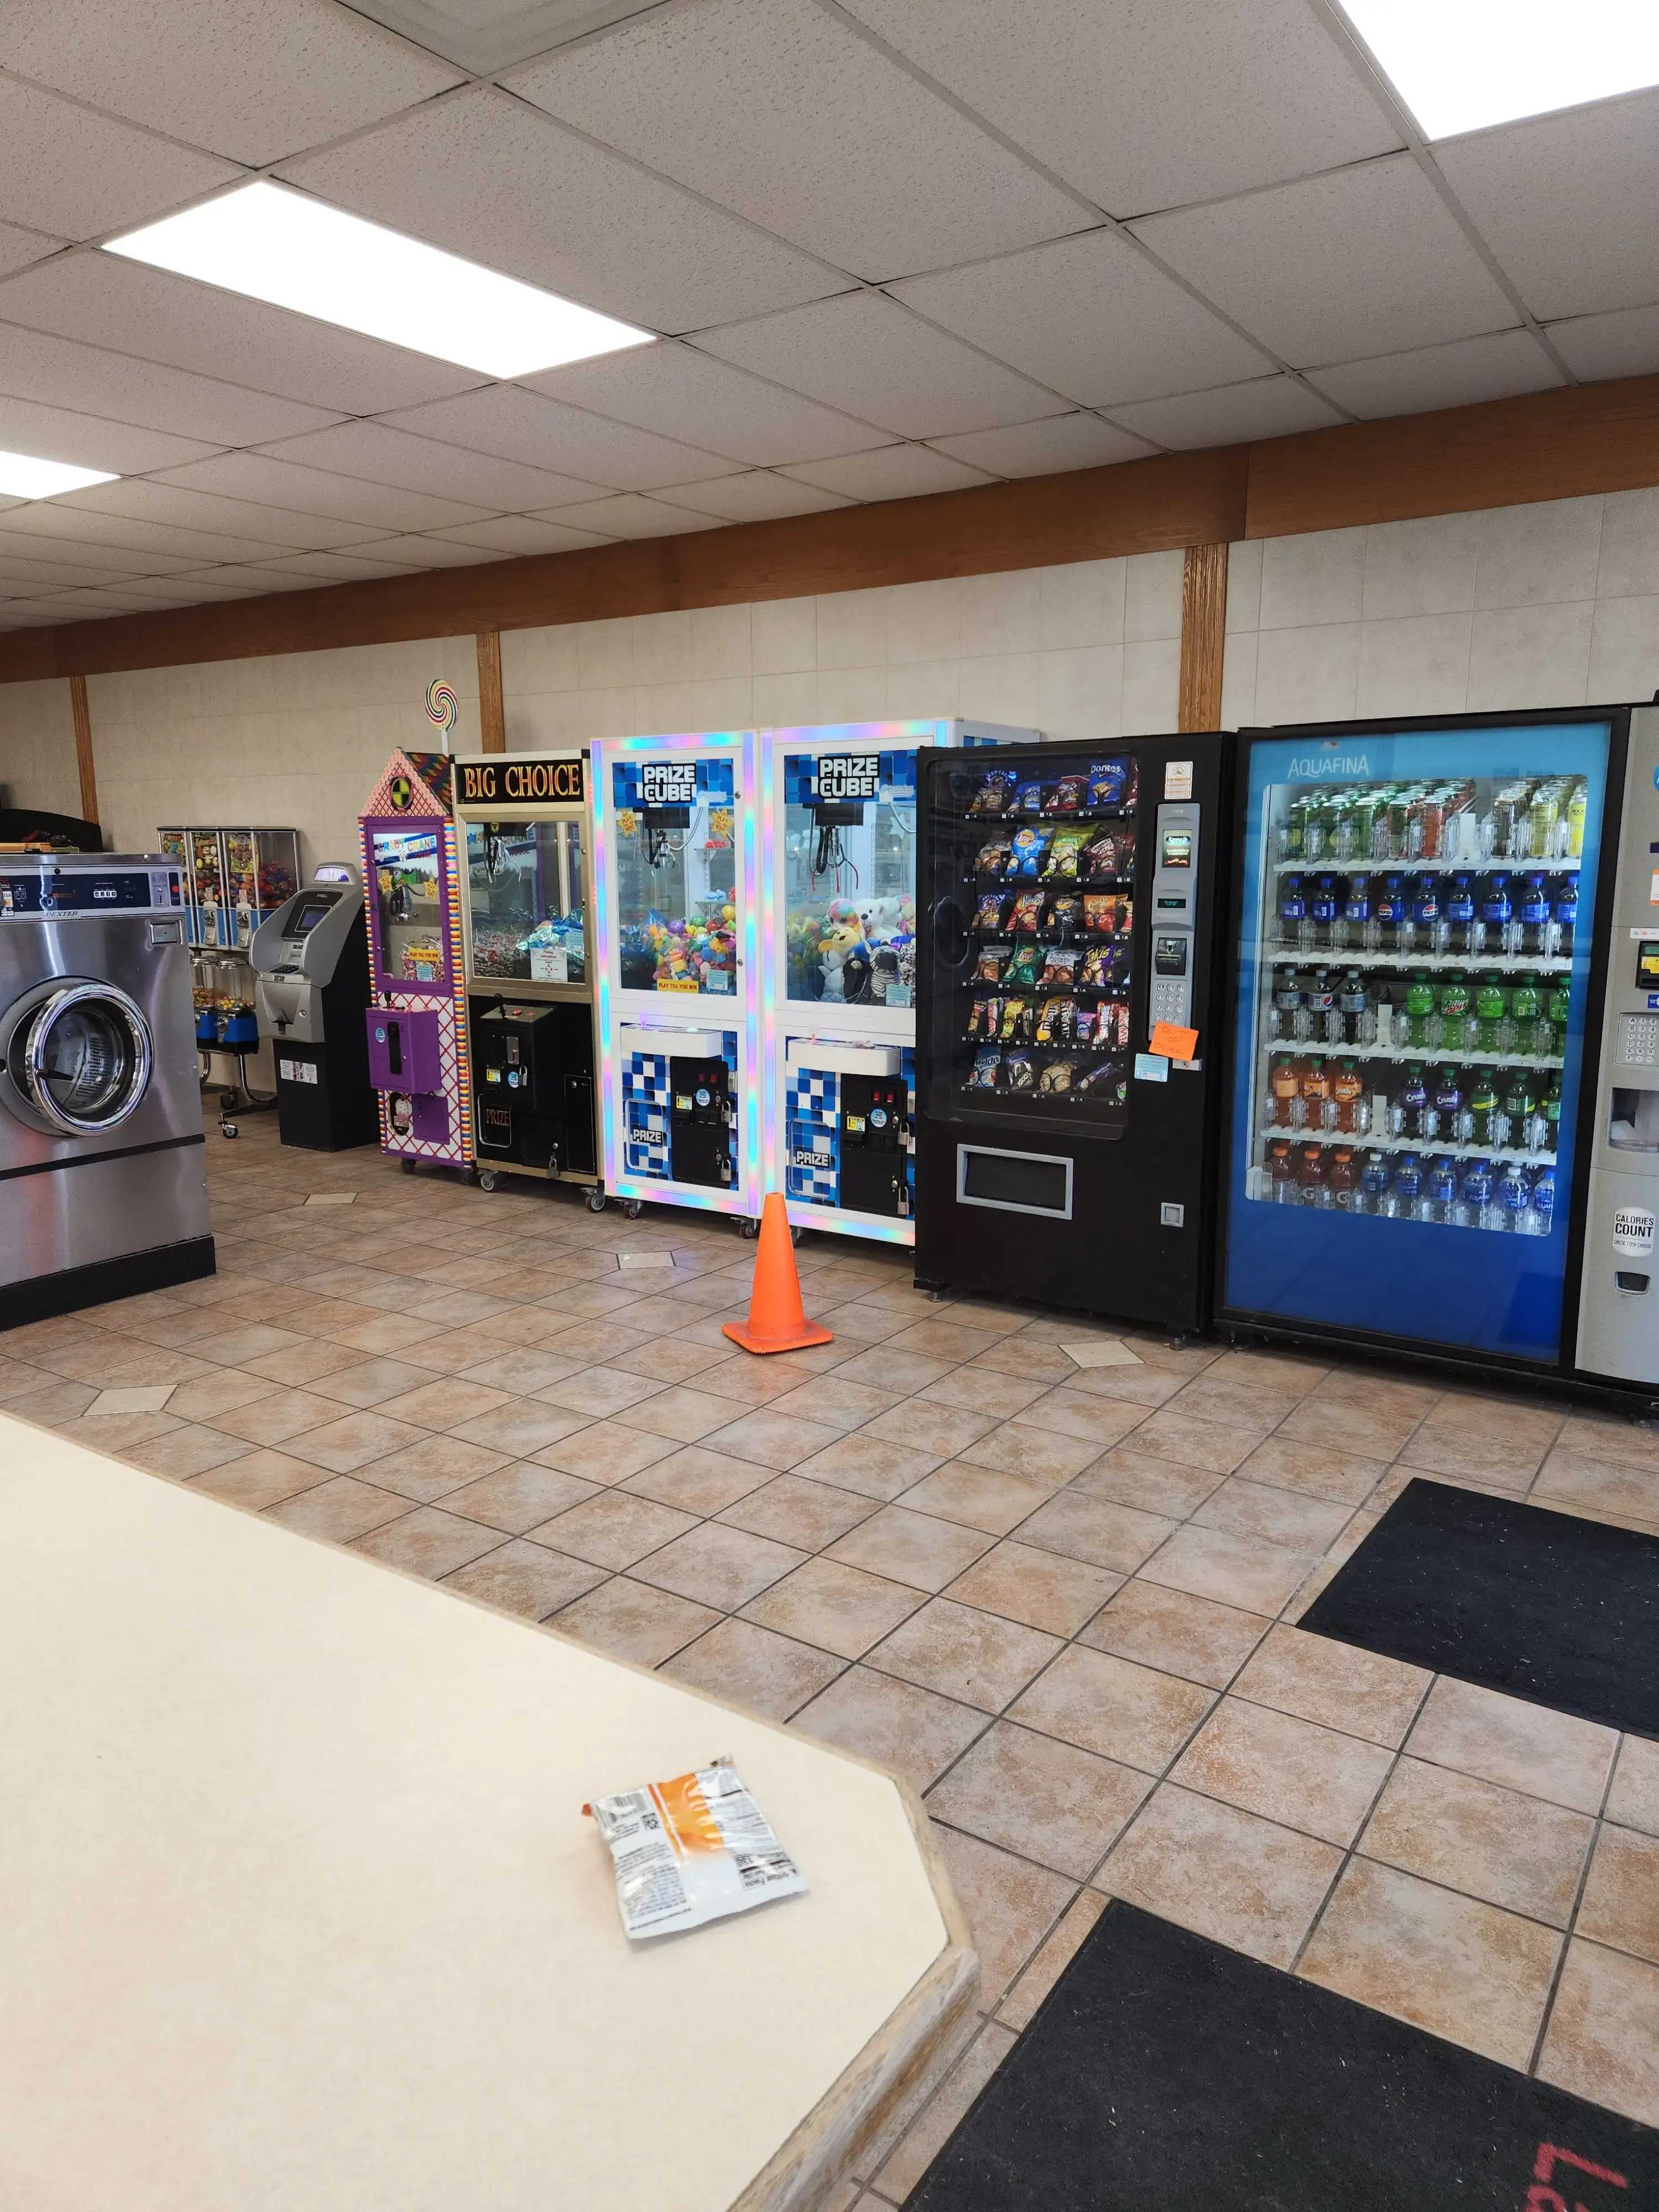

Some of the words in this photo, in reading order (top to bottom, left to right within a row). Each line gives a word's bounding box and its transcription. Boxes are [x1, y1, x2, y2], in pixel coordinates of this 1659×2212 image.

[820, 757, 878, 778] PRIZE
[1090, 764, 1121, 774] Doritos
[1287, 754, 1370, 779] AQUAFINA
[463, 766, 496, 797] BIG
[504, 764, 581, 797] CHOICE
[643, 765, 695, 784] PRIZE
[644, 784, 691, 801] CUBE
[820, 777, 873, 797] CUBE
[378, 838, 405, 852] CANDY
[408, 837, 436, 852] CRANE
[322, 869, 342, 880] ATM
[1162, 1026, 1190, 1037] OUT
[1154, 1042, 1185, 1055] ORDER
[974, 1056, 1000, 1066] Welch's
[1406, 1092, 1426, 1103] Crush
[486, 1109, 509, 1126] PRIZE
[633, 1129, 661, 1144] PRIZE
[796, 1150, 828, 1167] PRIZE
[1302, 1187, 1314, 1199] G
[1336, 1191, 1348, 1204] G
[1616, 1214, 1654, 1226] CALORIES
[1615, 1223, 1653, 1238] COUNT
